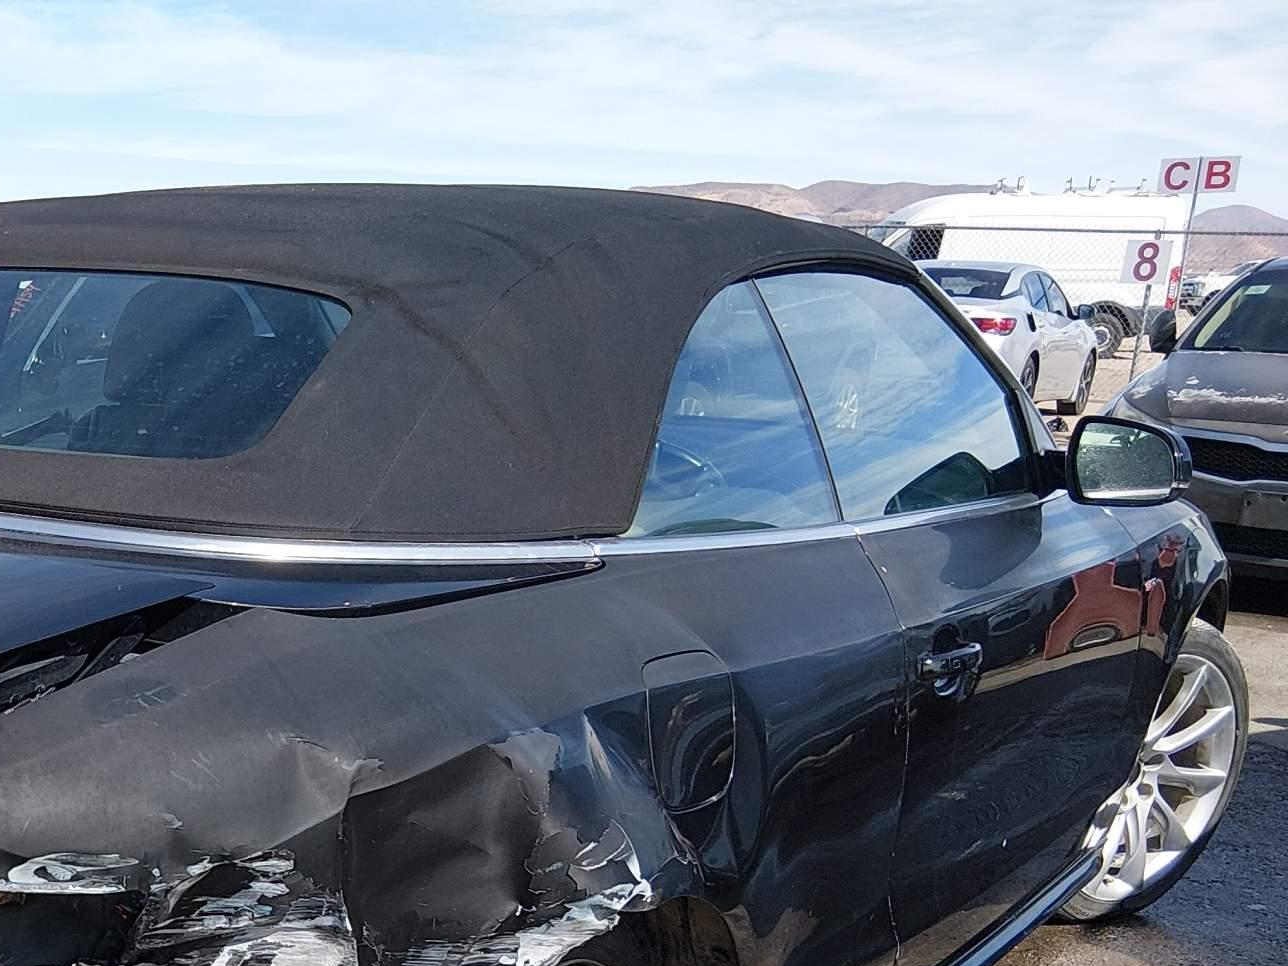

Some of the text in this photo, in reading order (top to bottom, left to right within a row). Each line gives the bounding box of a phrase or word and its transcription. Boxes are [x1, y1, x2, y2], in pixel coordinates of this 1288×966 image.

[1163, 161, 1191, 191] C
[1203, 160, 1232, 190] B
[1132, 242, 1160, 282] 8
